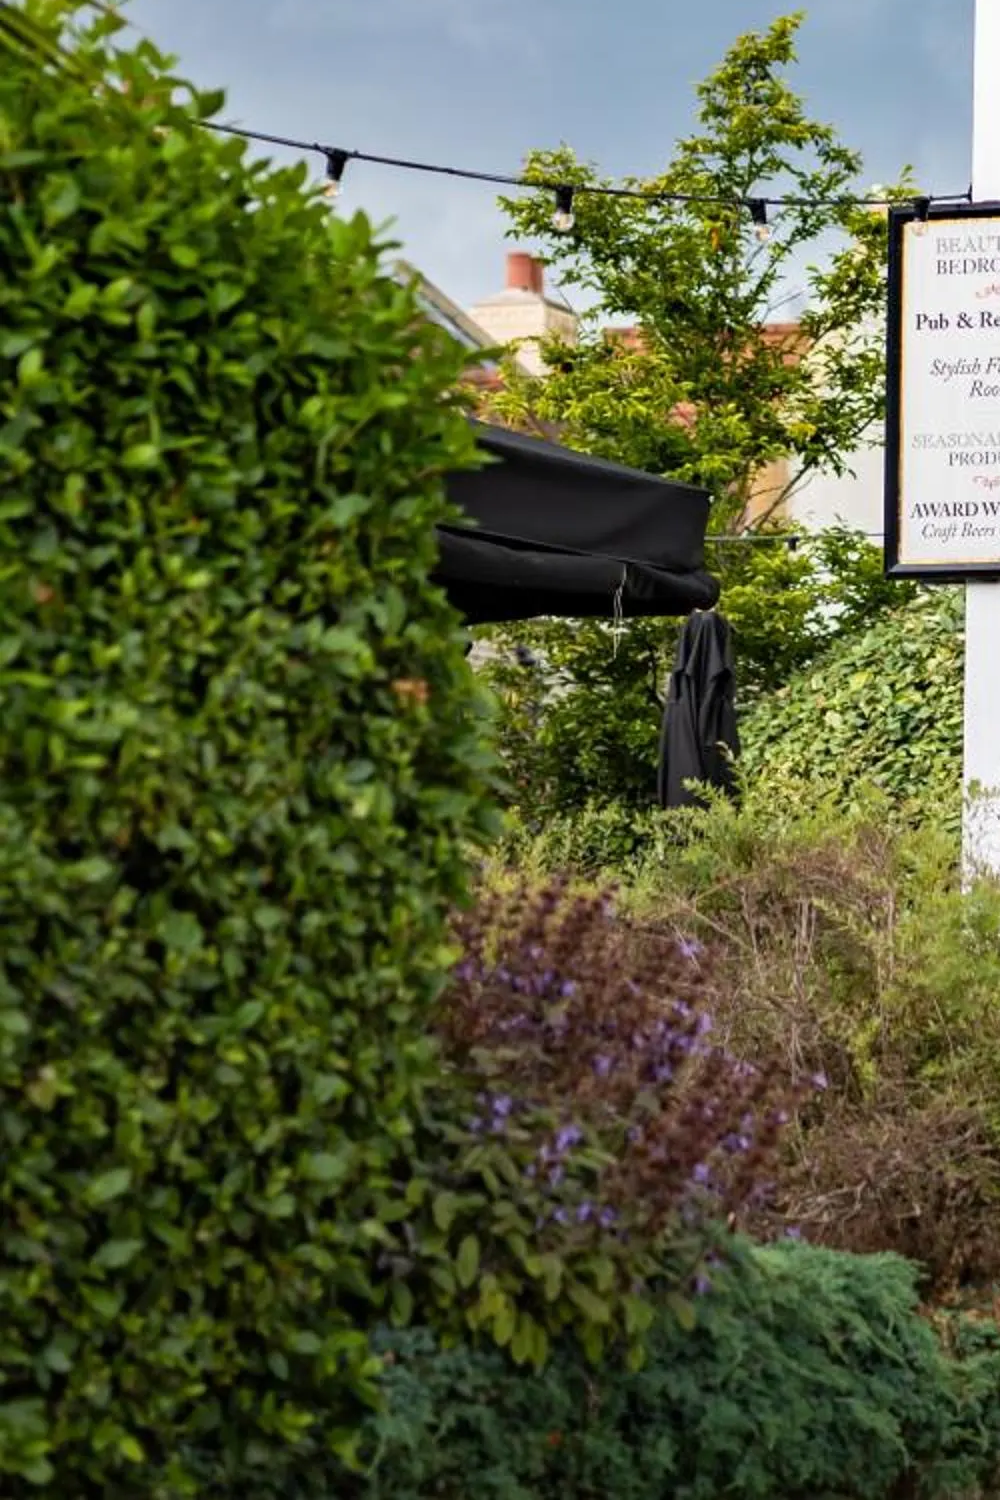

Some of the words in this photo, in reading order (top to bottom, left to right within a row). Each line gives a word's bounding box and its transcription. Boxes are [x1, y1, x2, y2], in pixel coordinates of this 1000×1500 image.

[915, 312, 949, 330] Pub
[957, 312, 973, 329] &
[929, 357, 981, 382] Stylish
[910, 501, 979, 519] AWARD
[921, 523, 958, 543] Craft
[961, 522, 996, 538] Beers
